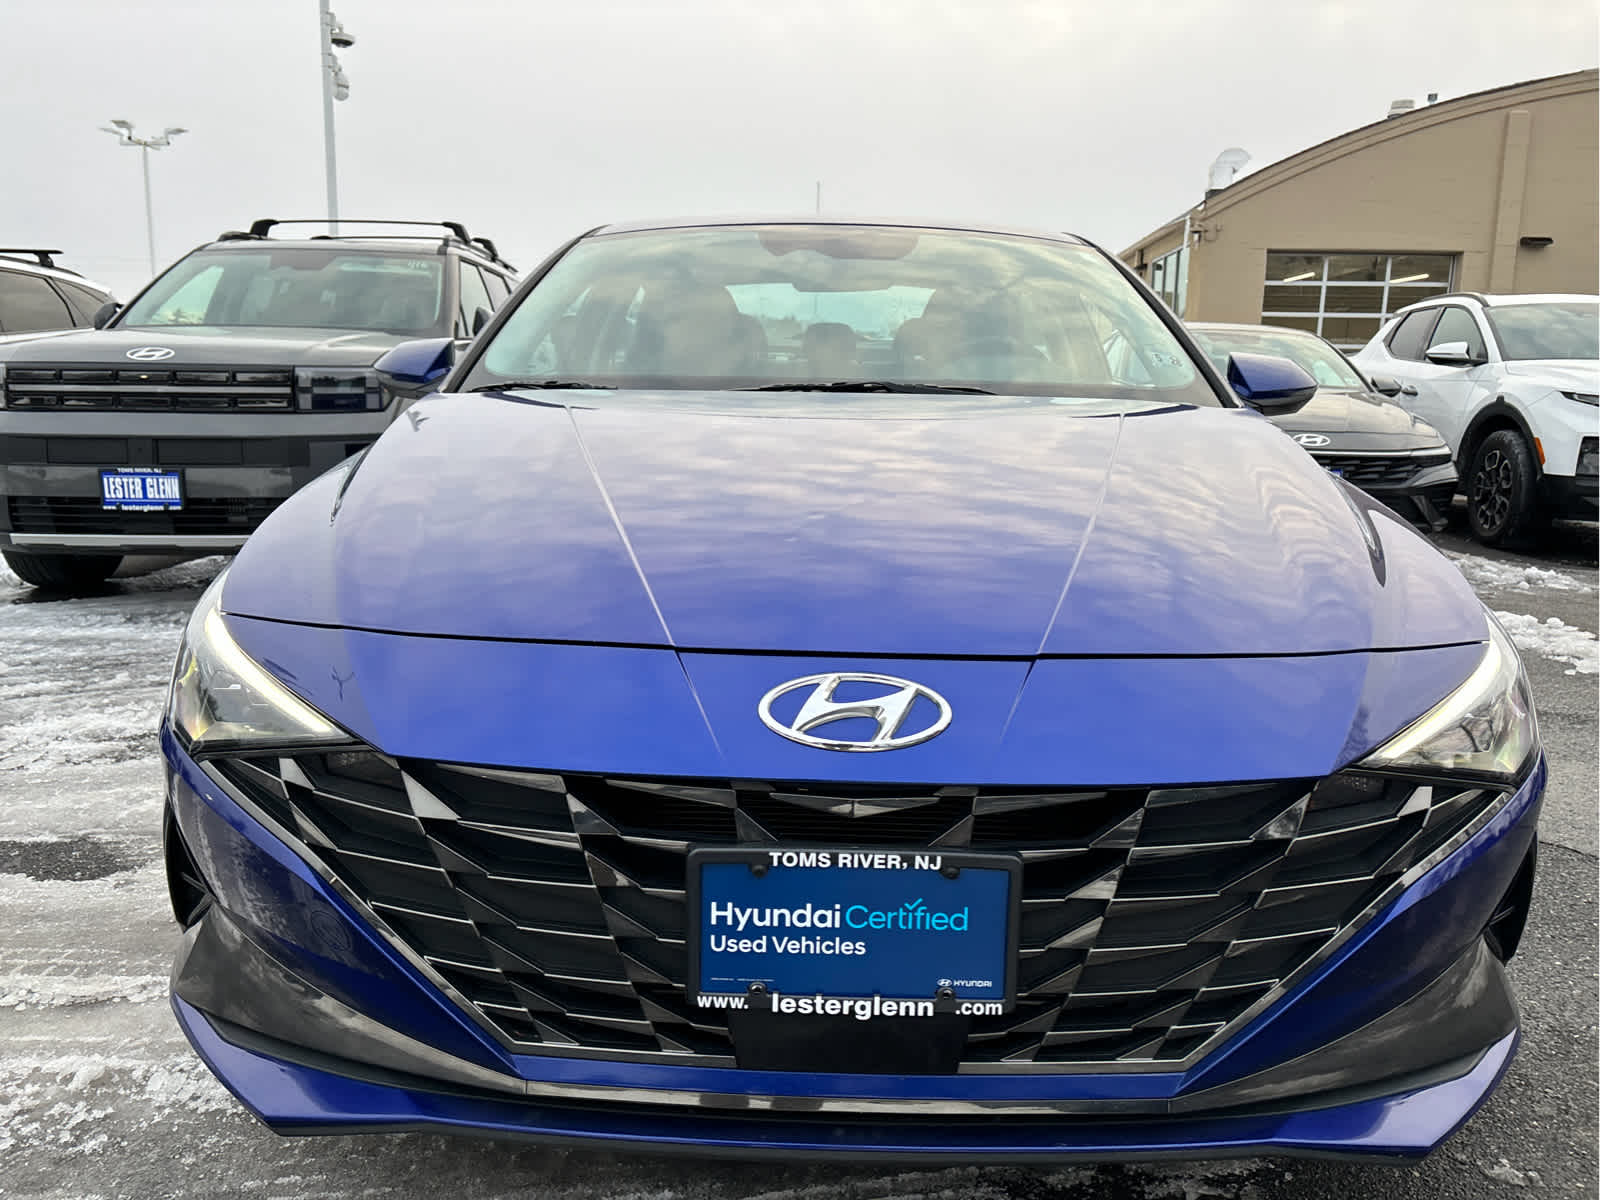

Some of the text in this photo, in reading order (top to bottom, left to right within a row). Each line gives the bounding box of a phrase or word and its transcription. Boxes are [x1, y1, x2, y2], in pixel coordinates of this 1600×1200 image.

[103, 477, 180, 499] LESTER GLENN
[769, 851, 943, 870] TOMS RIVER, NJ
[710, 898, 969, 931] Hyundai Certified
[710, 934, 867, 956] Used Vehicles
[953, 979, 993, 988] HYUNDAI
[697, 993, 1003, 1021] www. lesterglenn .com
